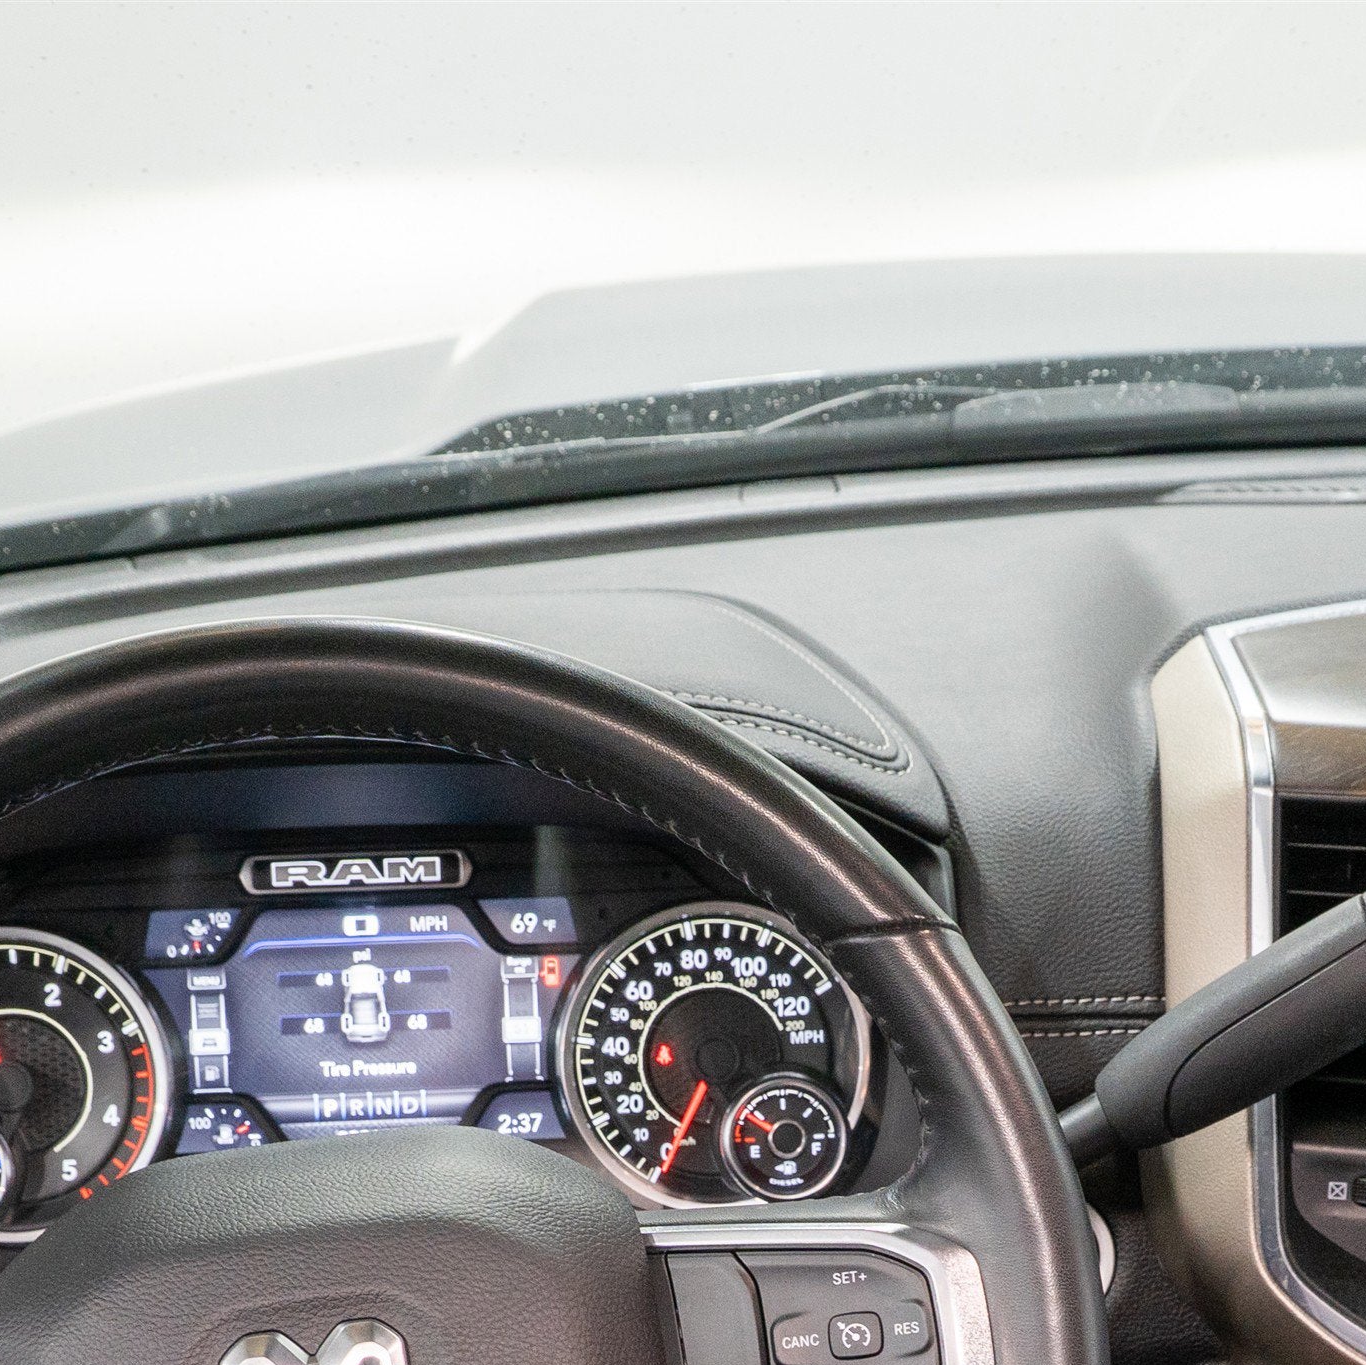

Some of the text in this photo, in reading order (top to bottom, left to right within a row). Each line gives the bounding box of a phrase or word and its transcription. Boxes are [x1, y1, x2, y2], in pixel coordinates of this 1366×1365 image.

[270, 856, 442, 888] RAM
[409, 915, 449, 932] MPH
[511, 912, 538, 933] 69
[352, 948, 372, 963] psi
[680, 948, 709, 970] 80
[714, 946, 733, 961] 90
[653, 962, 672, 977] 70
[730, 955, 768, 978] 100
[768, 973, 792, 988] 110
[43, 983, 63, 1008] 2
[624, 979, 654, 1001] 60
[609, 1007, 630, 1022] 50
[638, 1000, 658, 1012] 100
[773, 995, 812, 1018] 120
[303, 1013, 428, 1034] 68 68
[785, 1019, 806, 1032] 200
[96, 1031, 115, 1053] 3
[789, 1029, 825, 1045] MPH
[601, 1036, 630, 1057] 40
[318, 1059, 417, 1077] Tire Pressure
[603, 1070, 623, 1085] 30
[322, 1096, 419, 1118] P R N D
[615, 1094, 644, 1114] 20
[101, 1103, 121, 1127] 4
[187, 1116, 213, 1130] 100
[497, 1112, 543, 1134] 2:37
[633, 1127, 650, 1142] 10
[749, 1144, 762, 1159] E
[810, 1141, 822, 1156] F
[61, 1160, 78, 1181] 5
[832, 1271, 868, 1285] SET+
[894, 1321, 920, 1336] RES
[781, 1334, 820, 1350] CANC
